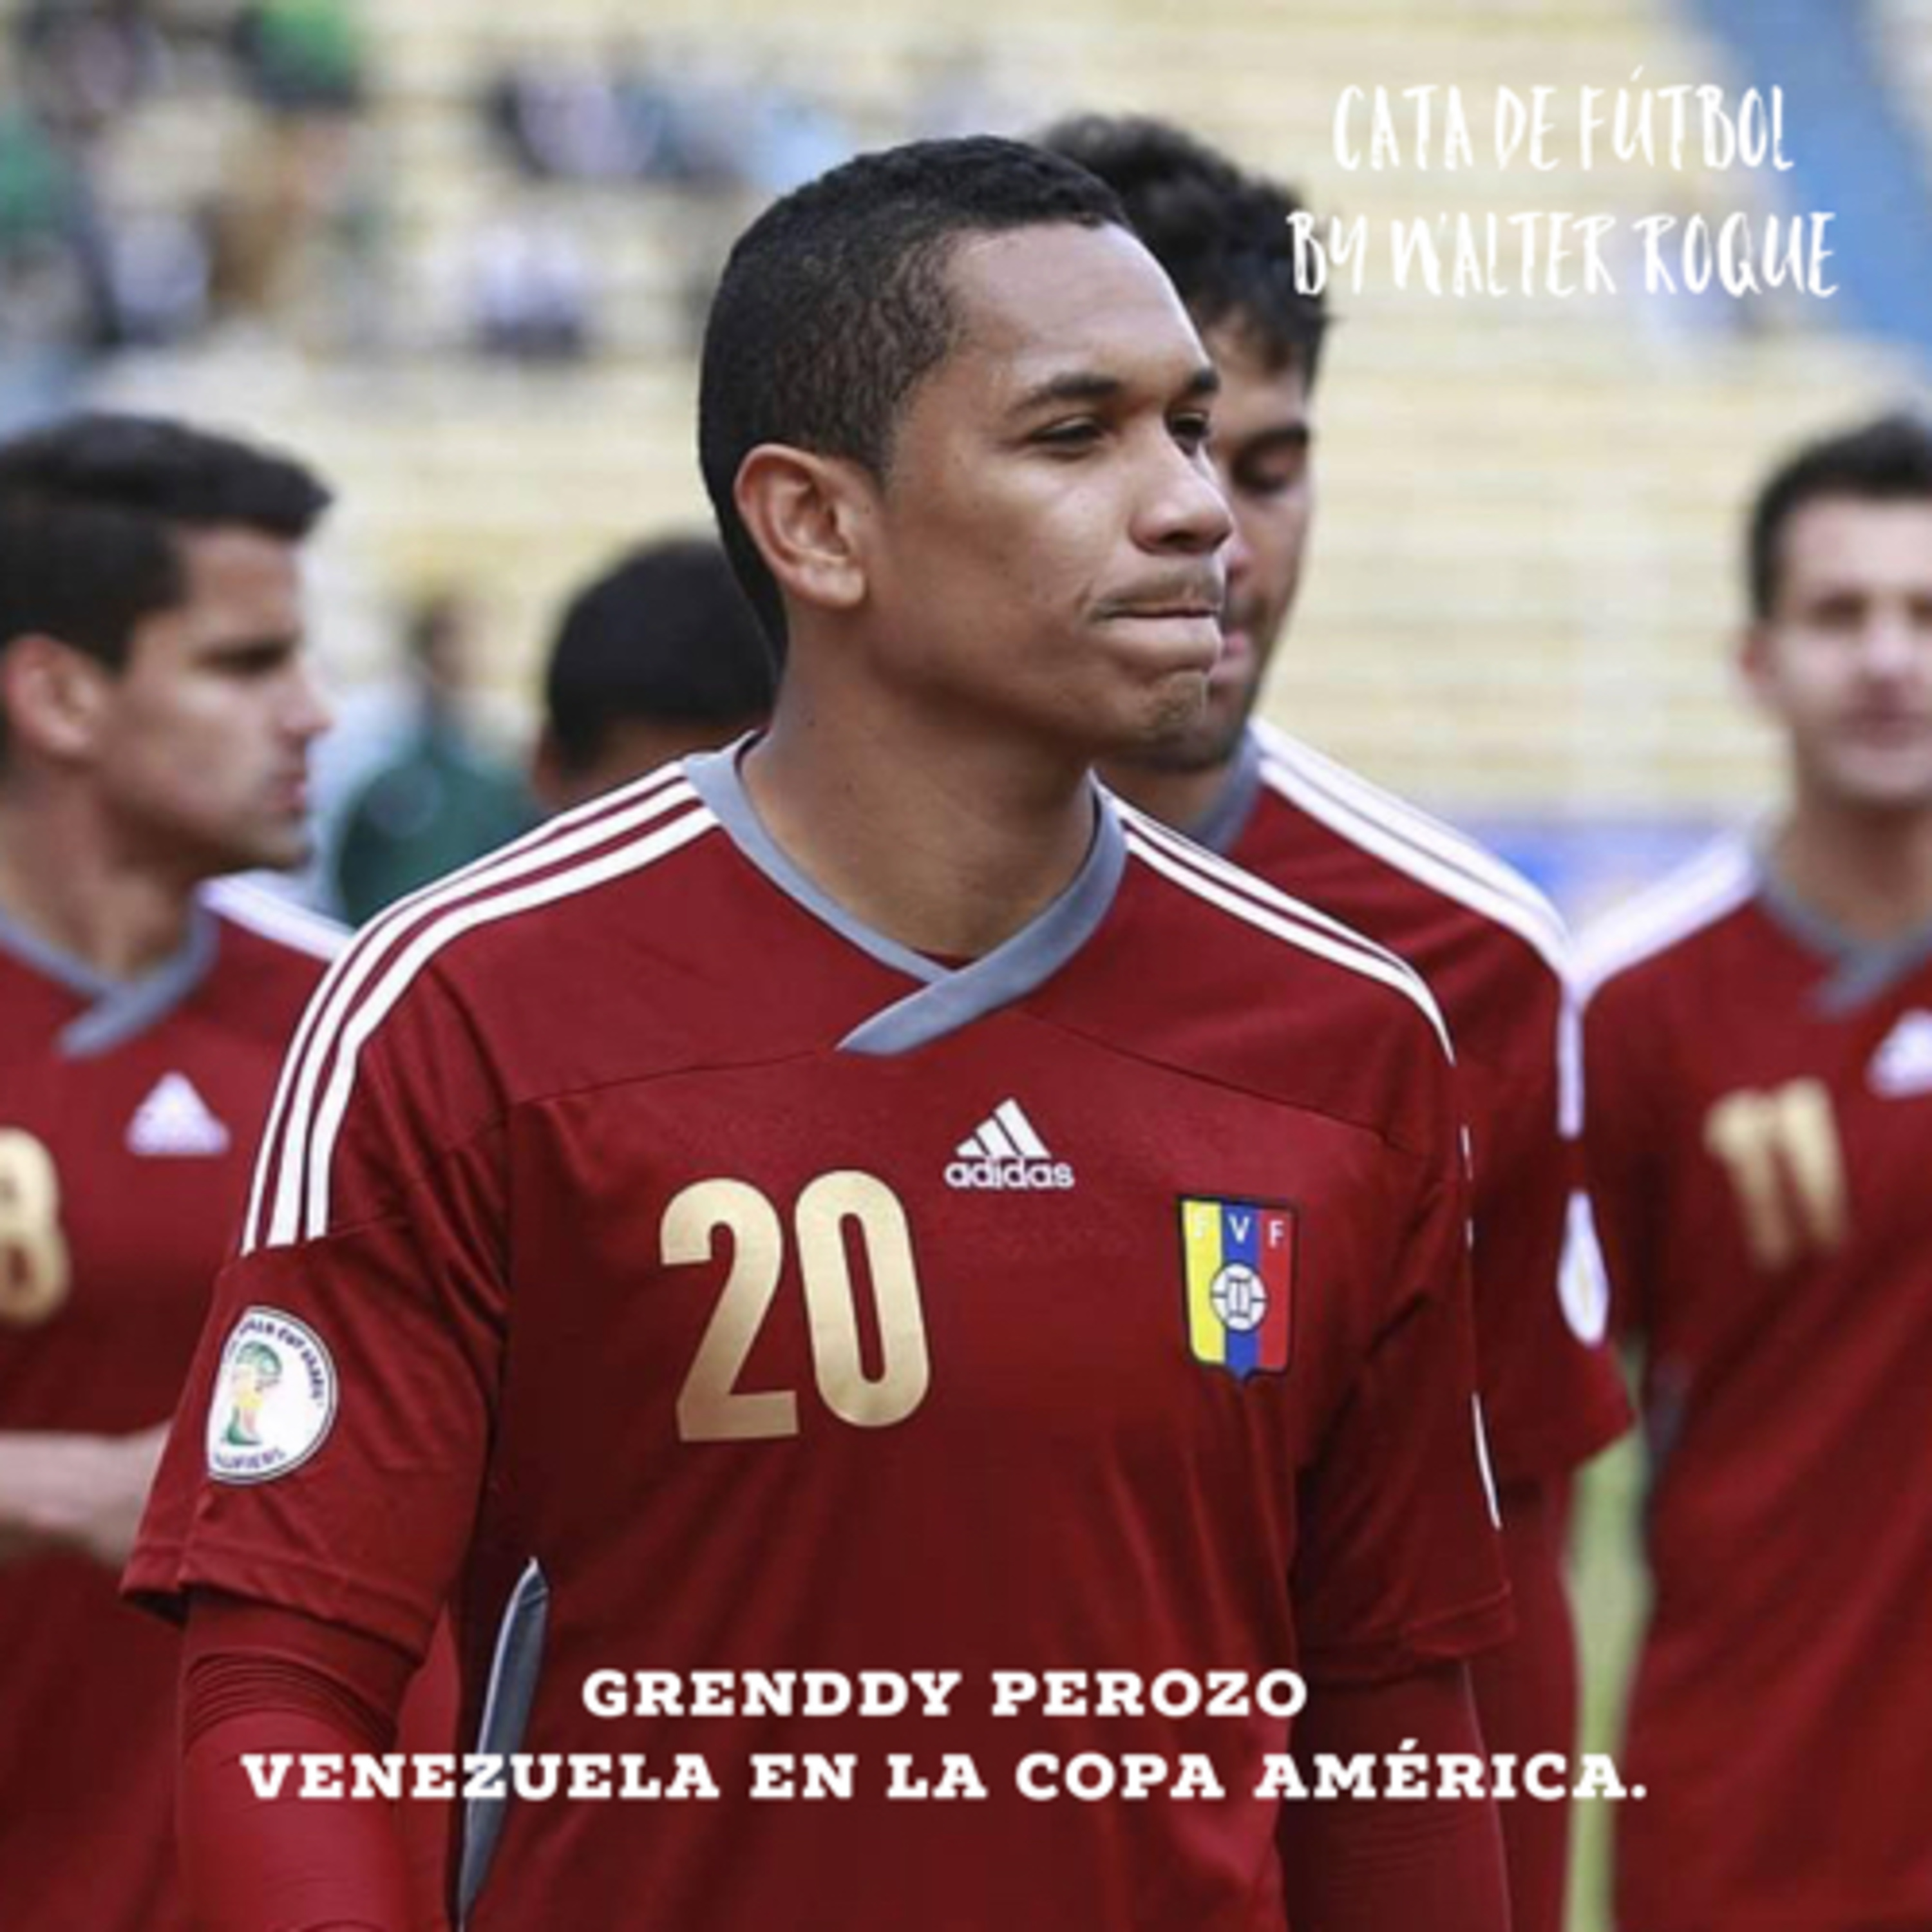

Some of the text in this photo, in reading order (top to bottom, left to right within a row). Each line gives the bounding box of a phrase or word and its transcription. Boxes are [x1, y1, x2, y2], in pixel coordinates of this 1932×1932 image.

[945, 1157, 1075, 1189] adidas
[1704, 1077, 1844, 1270] 11
[661, 1170, 929, 1442] 20
